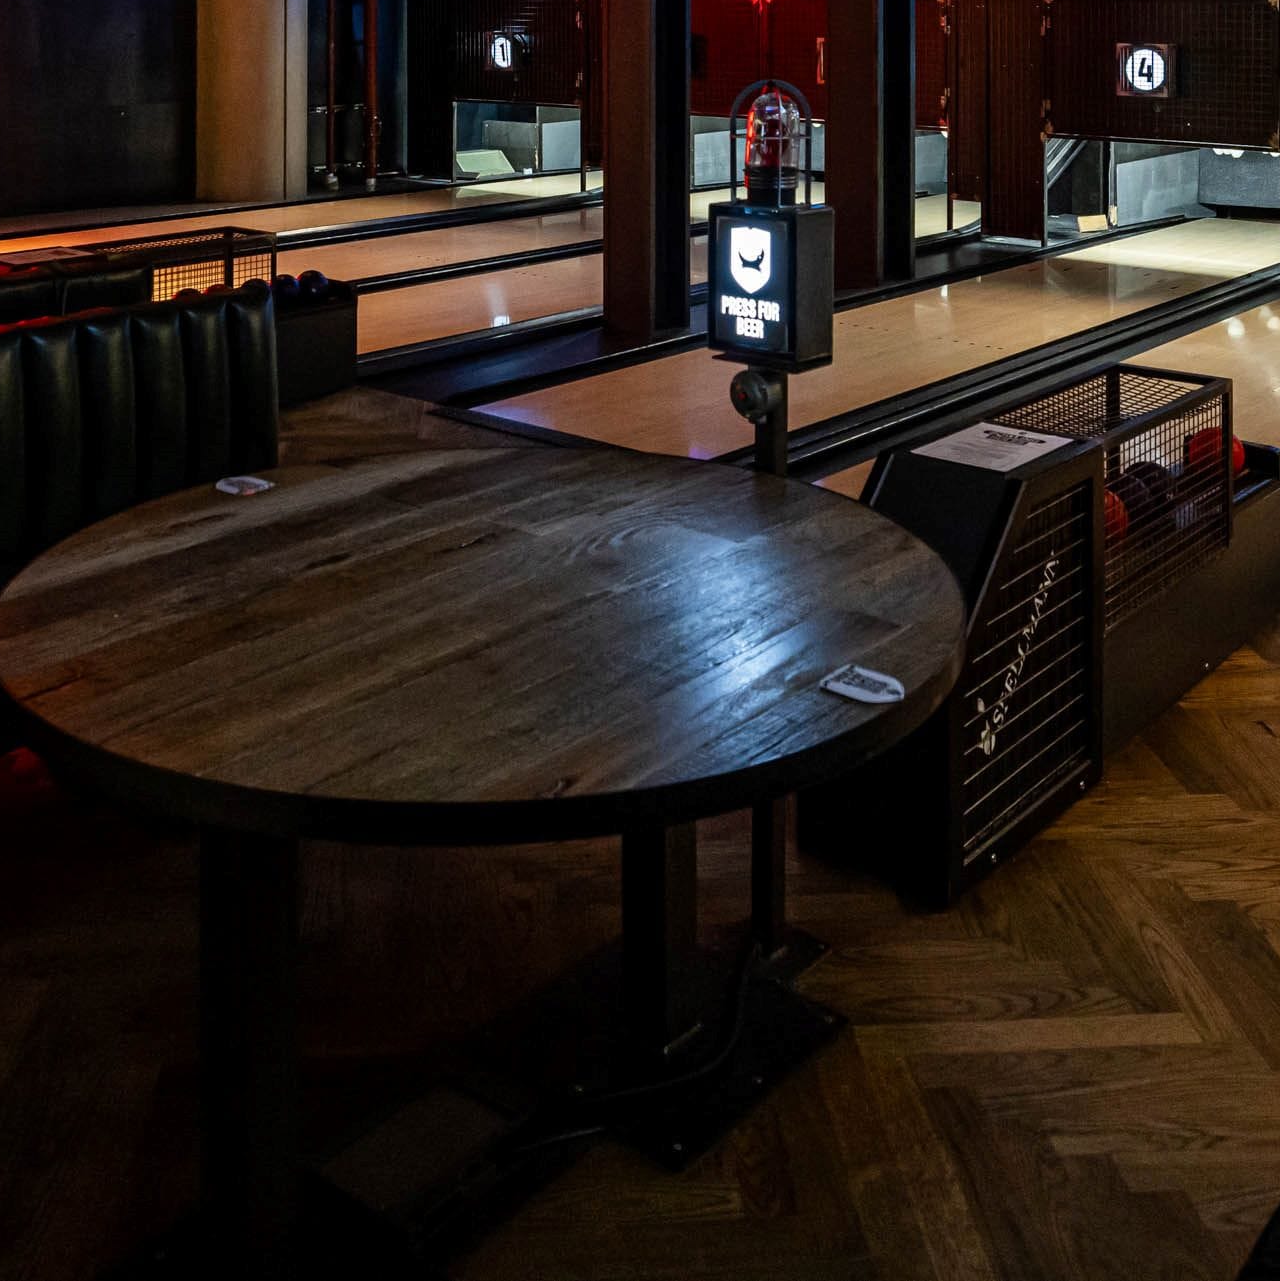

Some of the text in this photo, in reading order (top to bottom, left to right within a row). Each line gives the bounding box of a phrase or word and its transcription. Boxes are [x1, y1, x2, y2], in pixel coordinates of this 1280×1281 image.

[1138, 57, 1153, 83] 4
[721, 295, 780, 322] PRESS FOR
